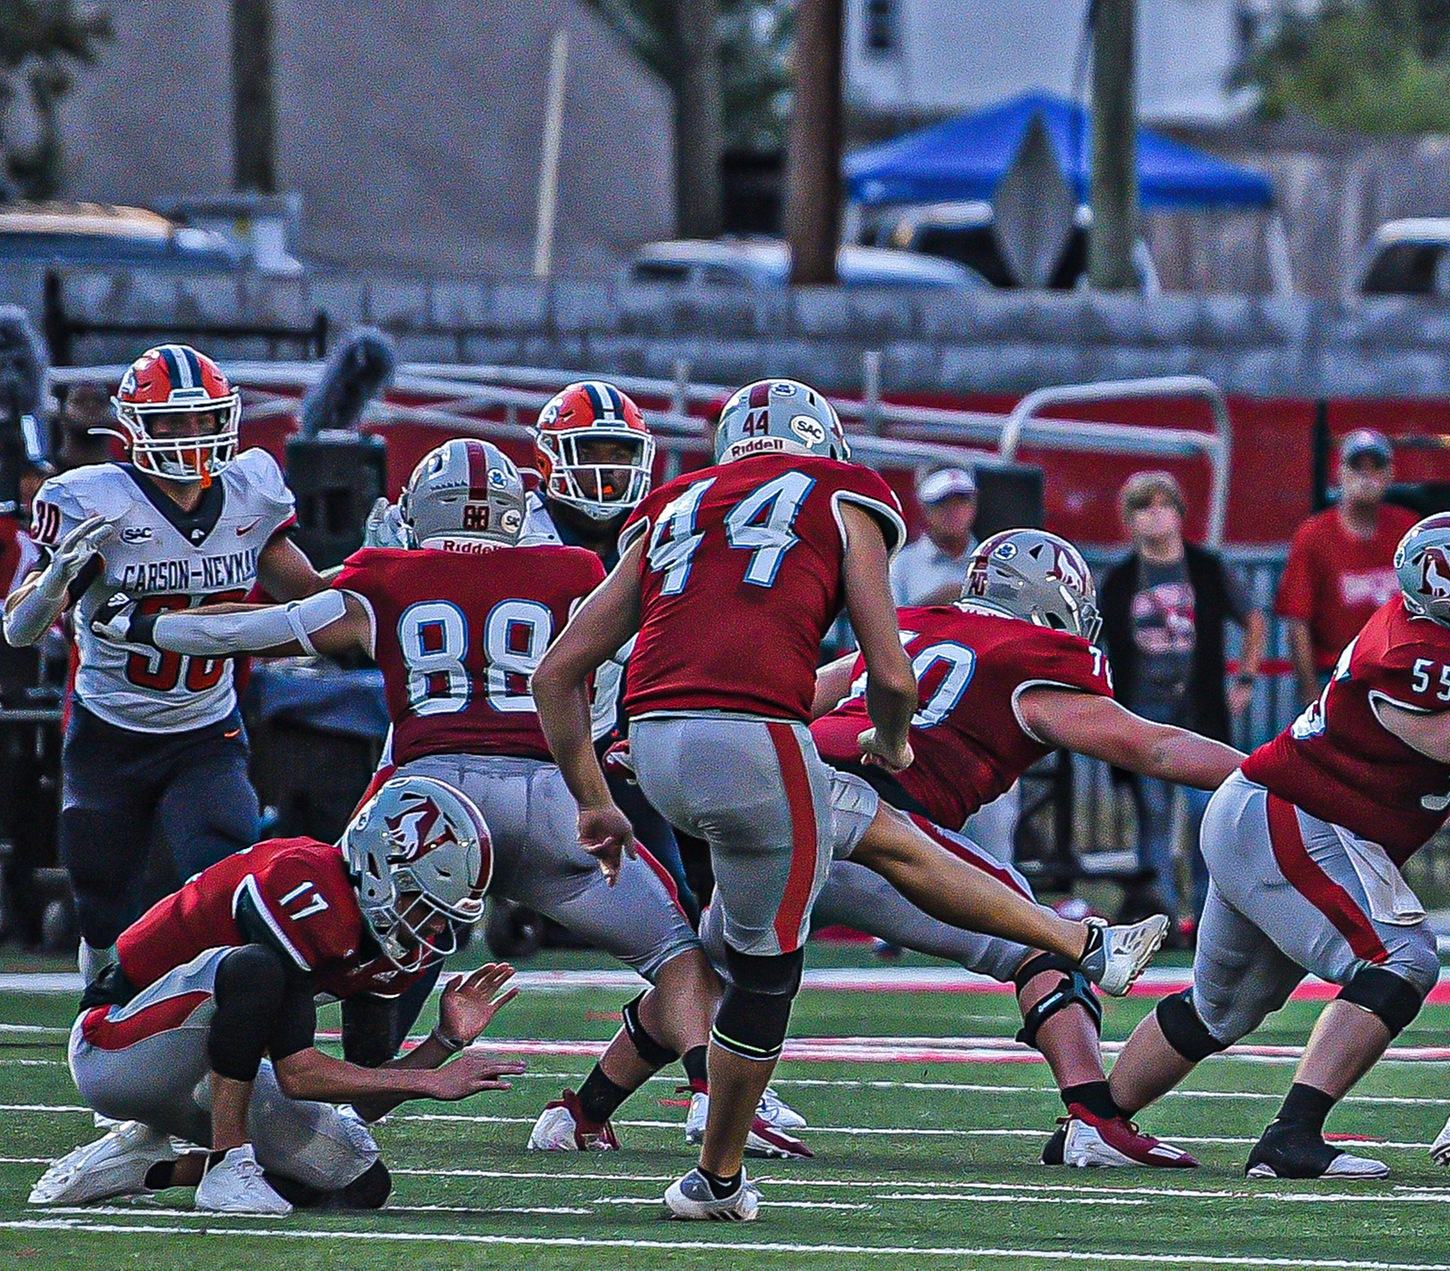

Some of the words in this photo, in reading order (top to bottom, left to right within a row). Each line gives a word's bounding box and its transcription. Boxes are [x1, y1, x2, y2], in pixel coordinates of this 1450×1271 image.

[742, 410, 769, 437] 44
[797, 420, 822, 440] SAC
[731, 440, 784, 457] Riddell
[123, 527, 153, 539] SAC
[646, 468, 817, 597] 44
[396, 597, 555, 718] 88
[279, 881, 330, 921] 17
